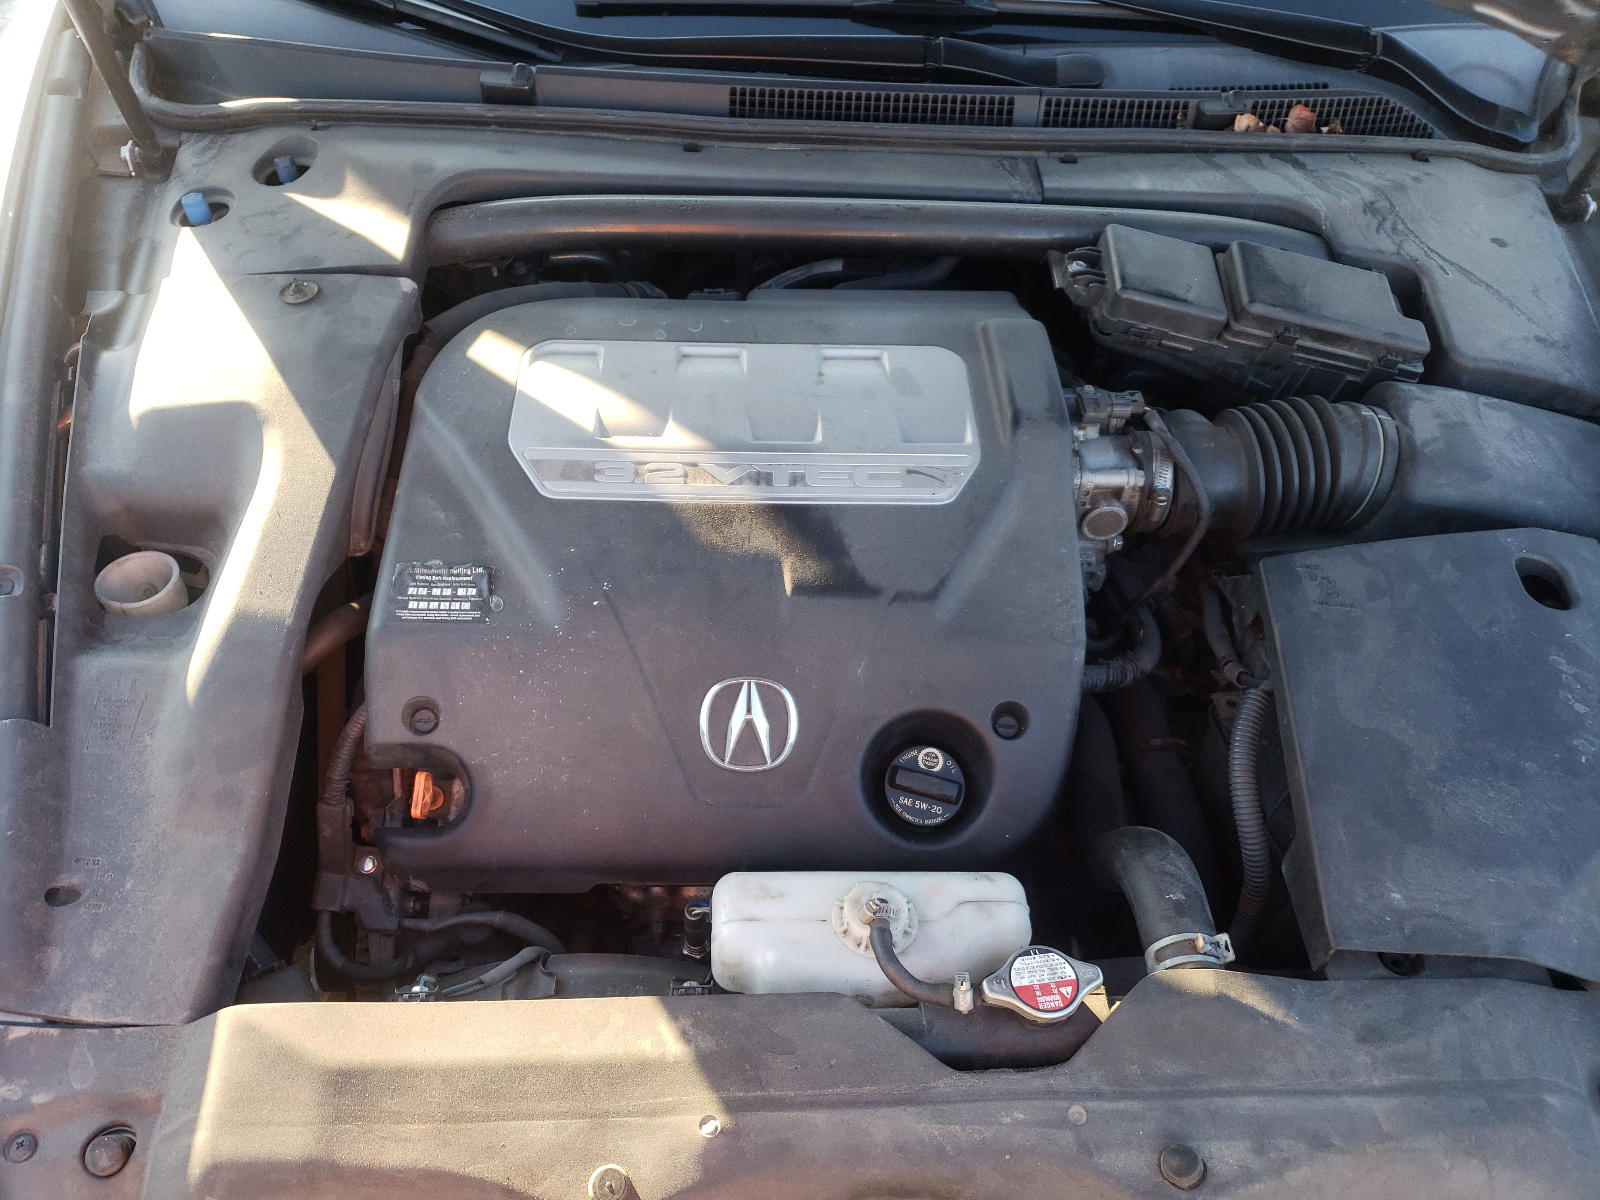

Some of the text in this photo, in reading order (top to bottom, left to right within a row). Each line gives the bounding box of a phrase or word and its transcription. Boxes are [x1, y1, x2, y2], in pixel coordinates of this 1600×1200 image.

[697, 462, 902, 488] VTEC
[899, 749, 919, 763] ENGINE
[899, 796, 942, 814] SAE 5W-20
[1039, 1001, 1064, 1010] DANGER
